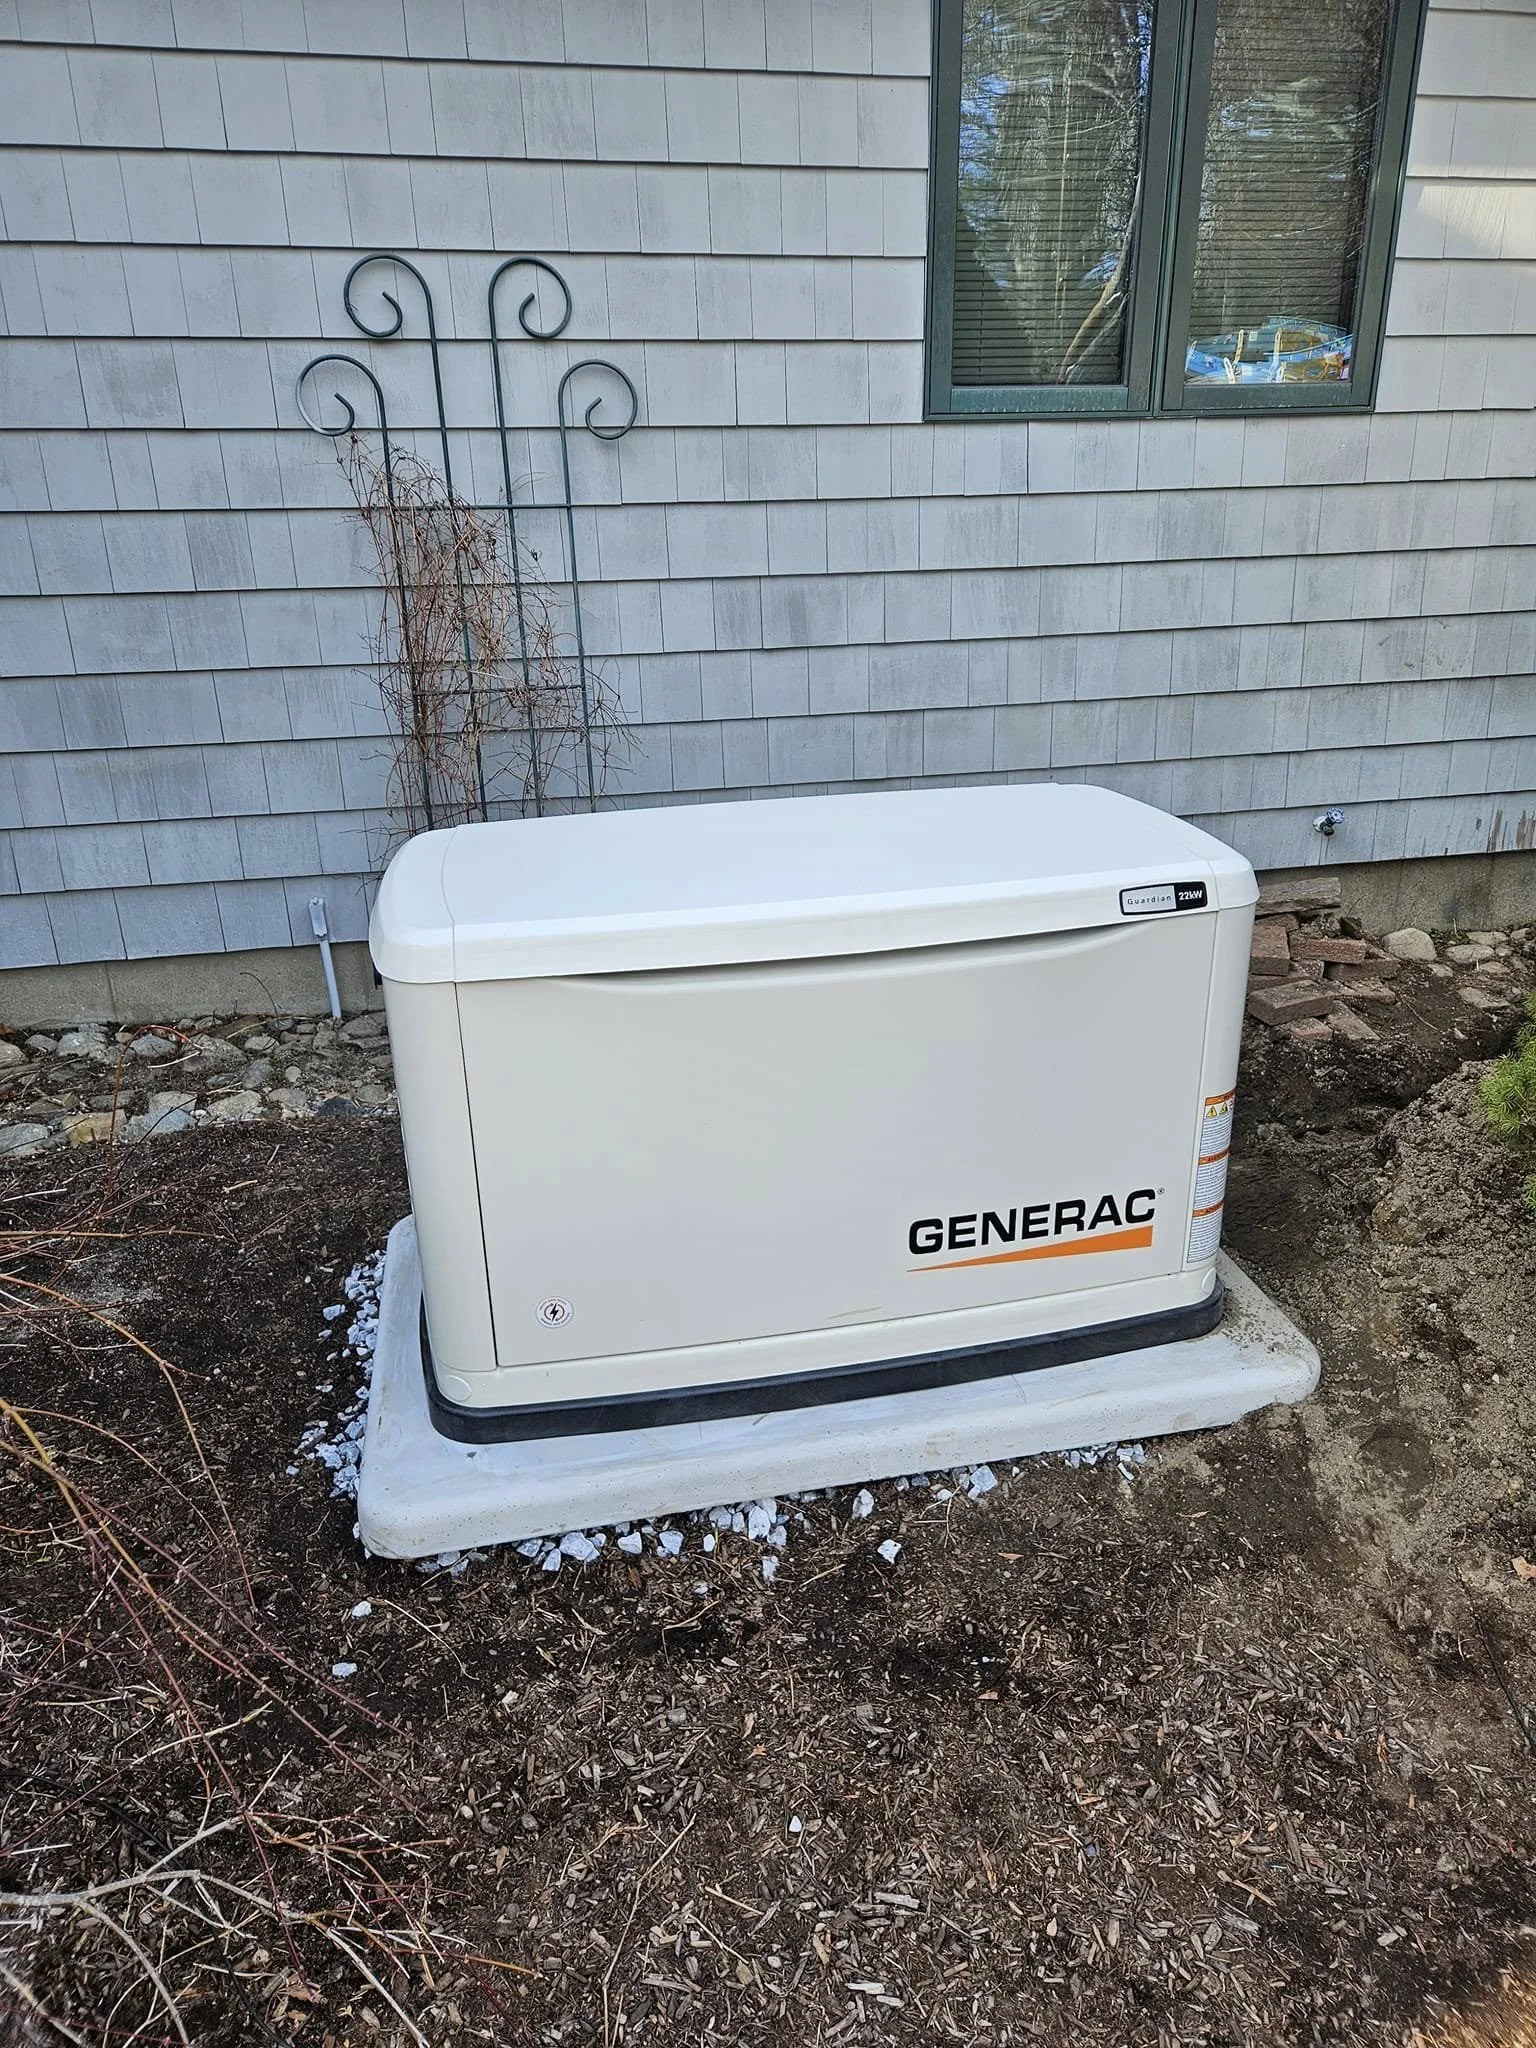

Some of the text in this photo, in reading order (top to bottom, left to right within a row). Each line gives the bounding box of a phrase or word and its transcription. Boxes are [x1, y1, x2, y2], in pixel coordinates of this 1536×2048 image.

[1127, 890, 1203, 905] Guardian 22kW
[908, 1188, 1156, 1255] GENERAC
